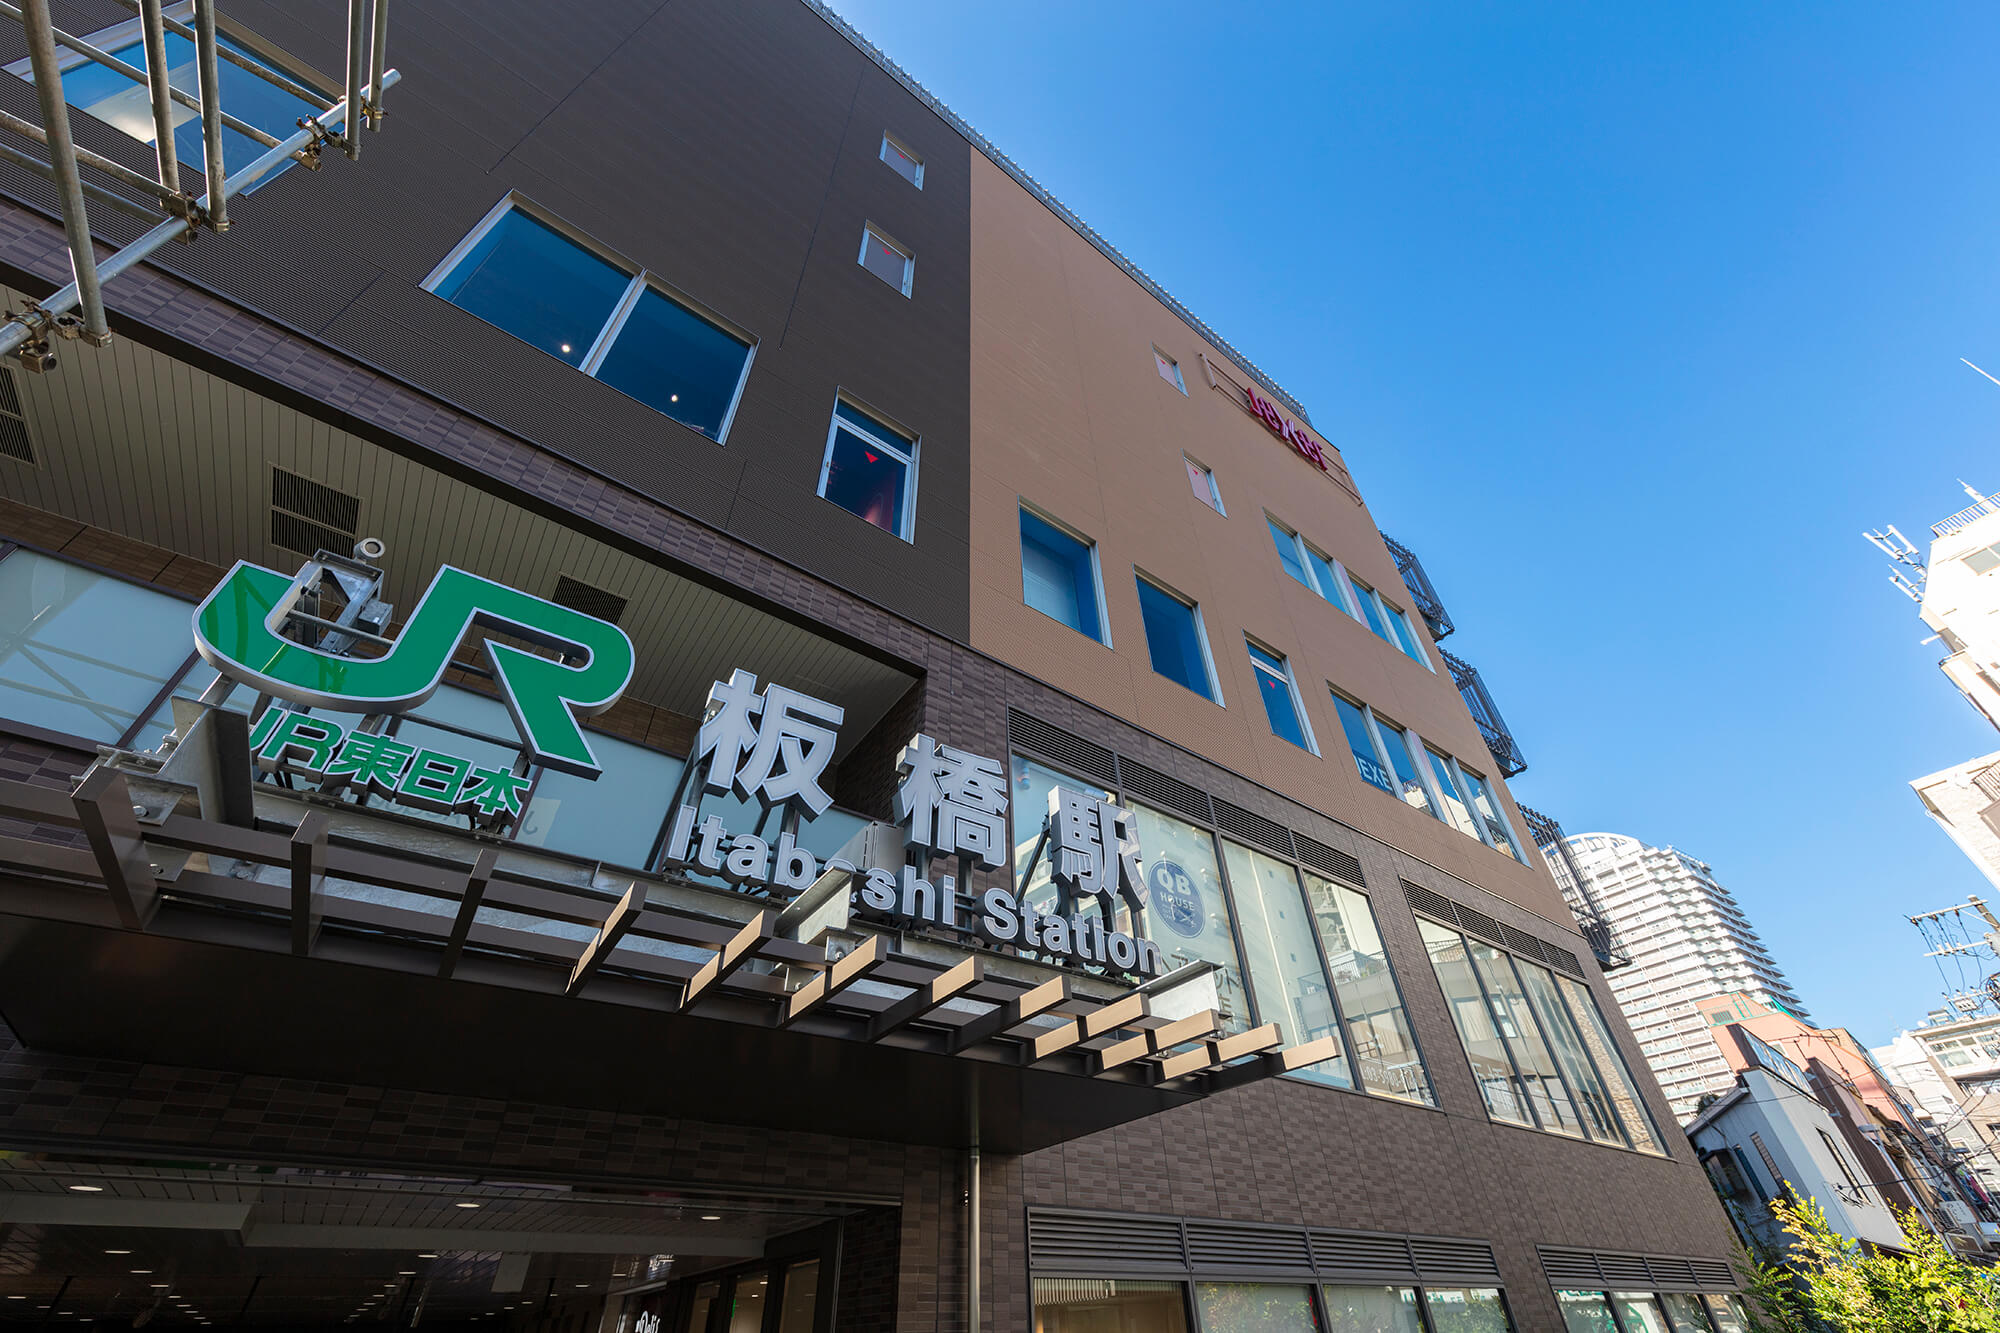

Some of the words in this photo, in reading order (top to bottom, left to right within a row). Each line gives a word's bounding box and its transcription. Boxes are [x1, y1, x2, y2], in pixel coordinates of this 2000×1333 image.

[192, 559, 636, 775] JR
[251, 706, 532, 818] JR東日本
[699, 668, 1150, 912] 板橋駅
[668, 804, 955, 926] Itabshi
[981, 887, 1162, 977] Station
[1156, 868, 1192, 895] QB
[1160, 891, 1196, 911] HOUSE
